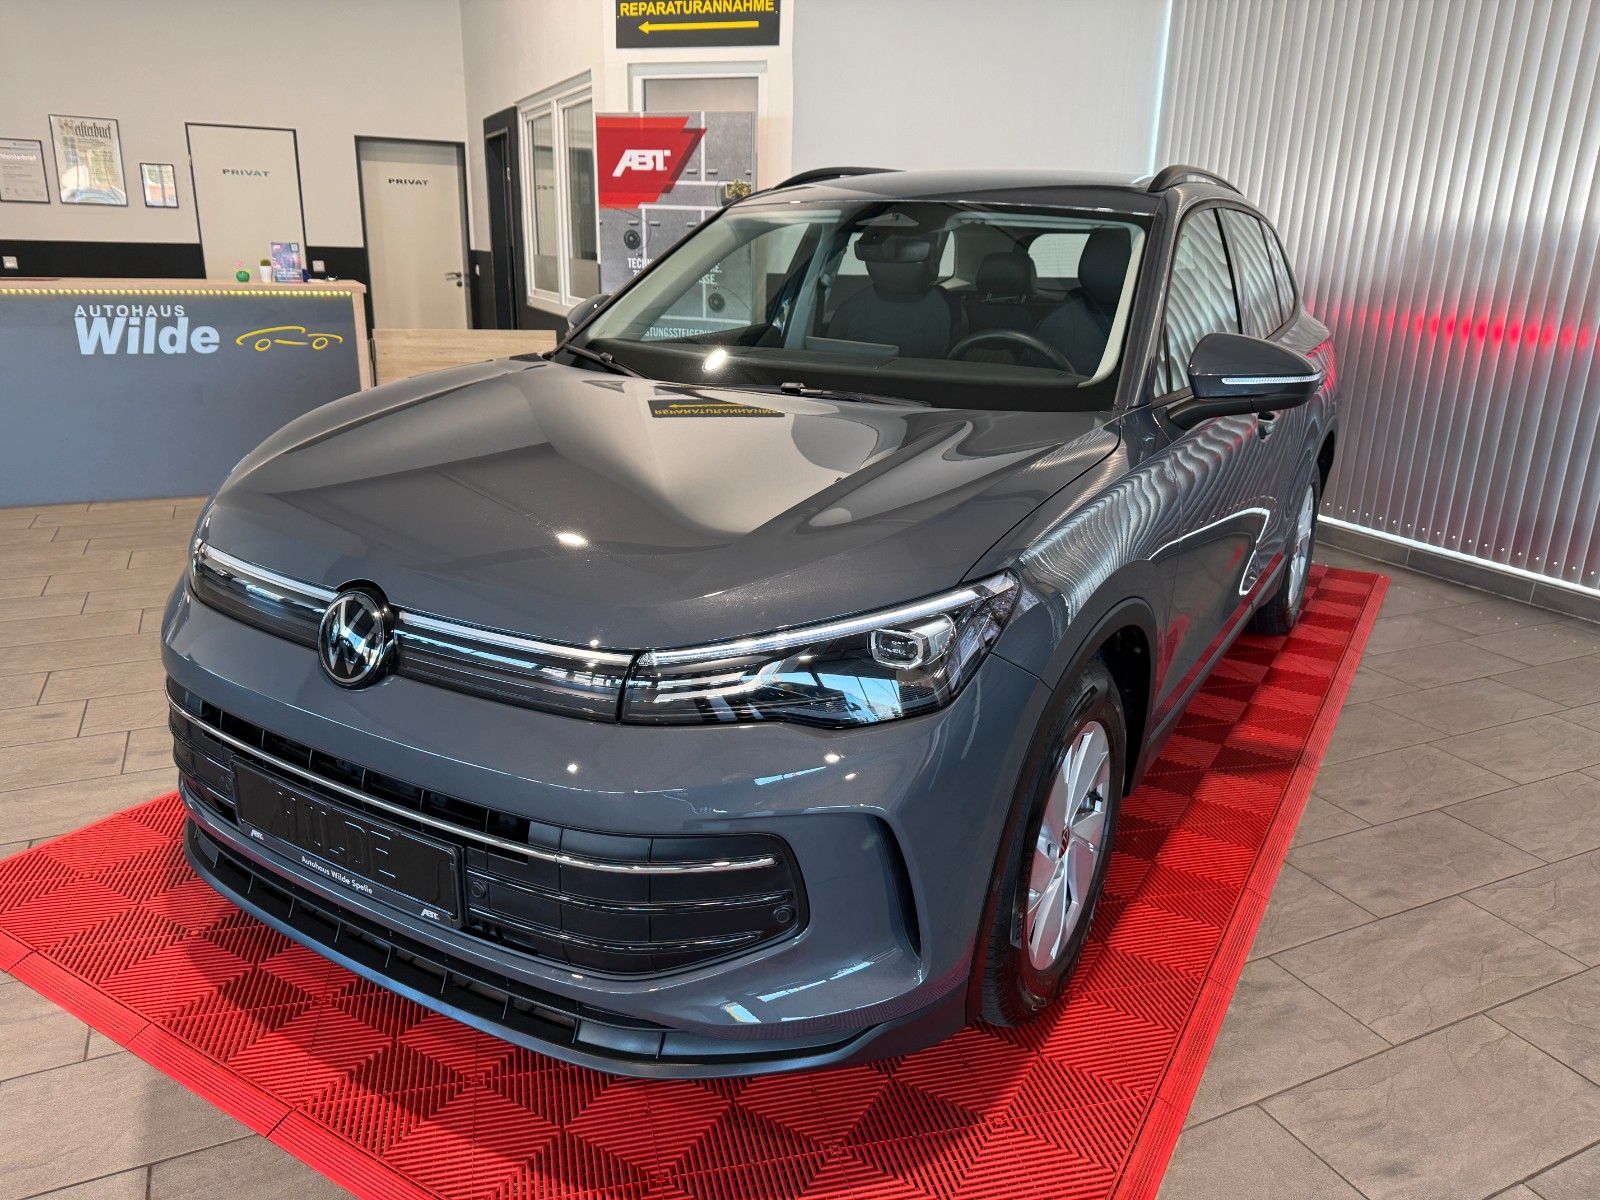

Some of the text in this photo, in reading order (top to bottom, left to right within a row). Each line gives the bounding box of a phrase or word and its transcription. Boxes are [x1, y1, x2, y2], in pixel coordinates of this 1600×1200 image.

[620, 0, 774, 16] REPARATURANNAHME
[612, 149, 672, 177] ABT
[222, 168, 271, 178] PRIVAT
[388, 178, 430, 186] PRIVAT
[74, 304, 185, 318] AUTOHAUS
[74, 316, 221, 355] Wilde
[301, 855, 330, 876] Autohaus
[330, 869, 350, 885] Wilde
[420, 908, 440, 921] ABT
